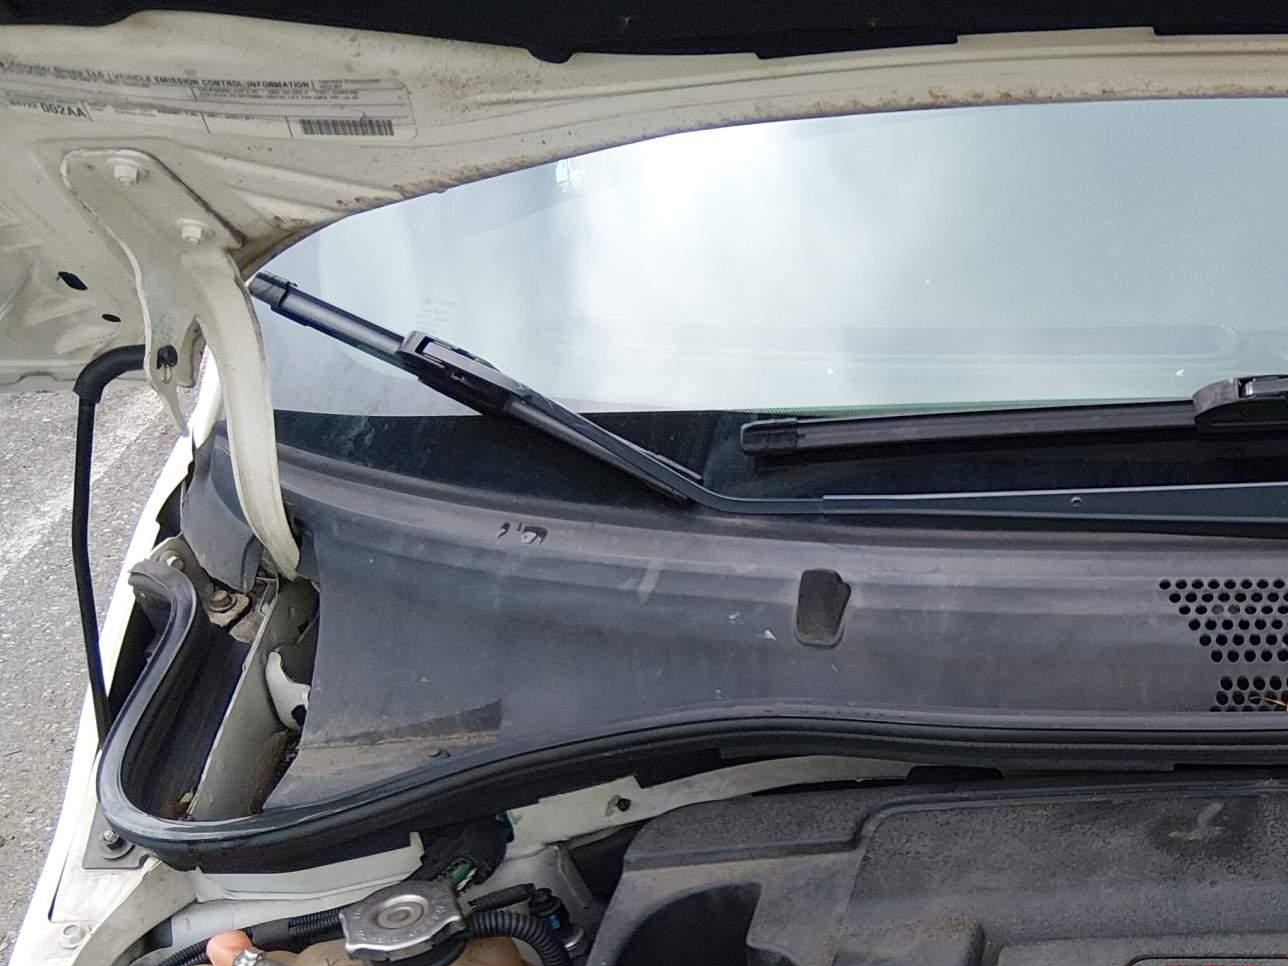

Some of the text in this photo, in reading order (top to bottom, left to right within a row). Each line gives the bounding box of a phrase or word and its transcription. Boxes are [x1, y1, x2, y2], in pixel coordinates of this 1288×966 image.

[114, 73, 151, 83] VEHICLE
[153, 76, 199, 86] EMISSION
[202, 79, 242, 88] CONTROL
[246, 80, 310, 89] INFORMATION
